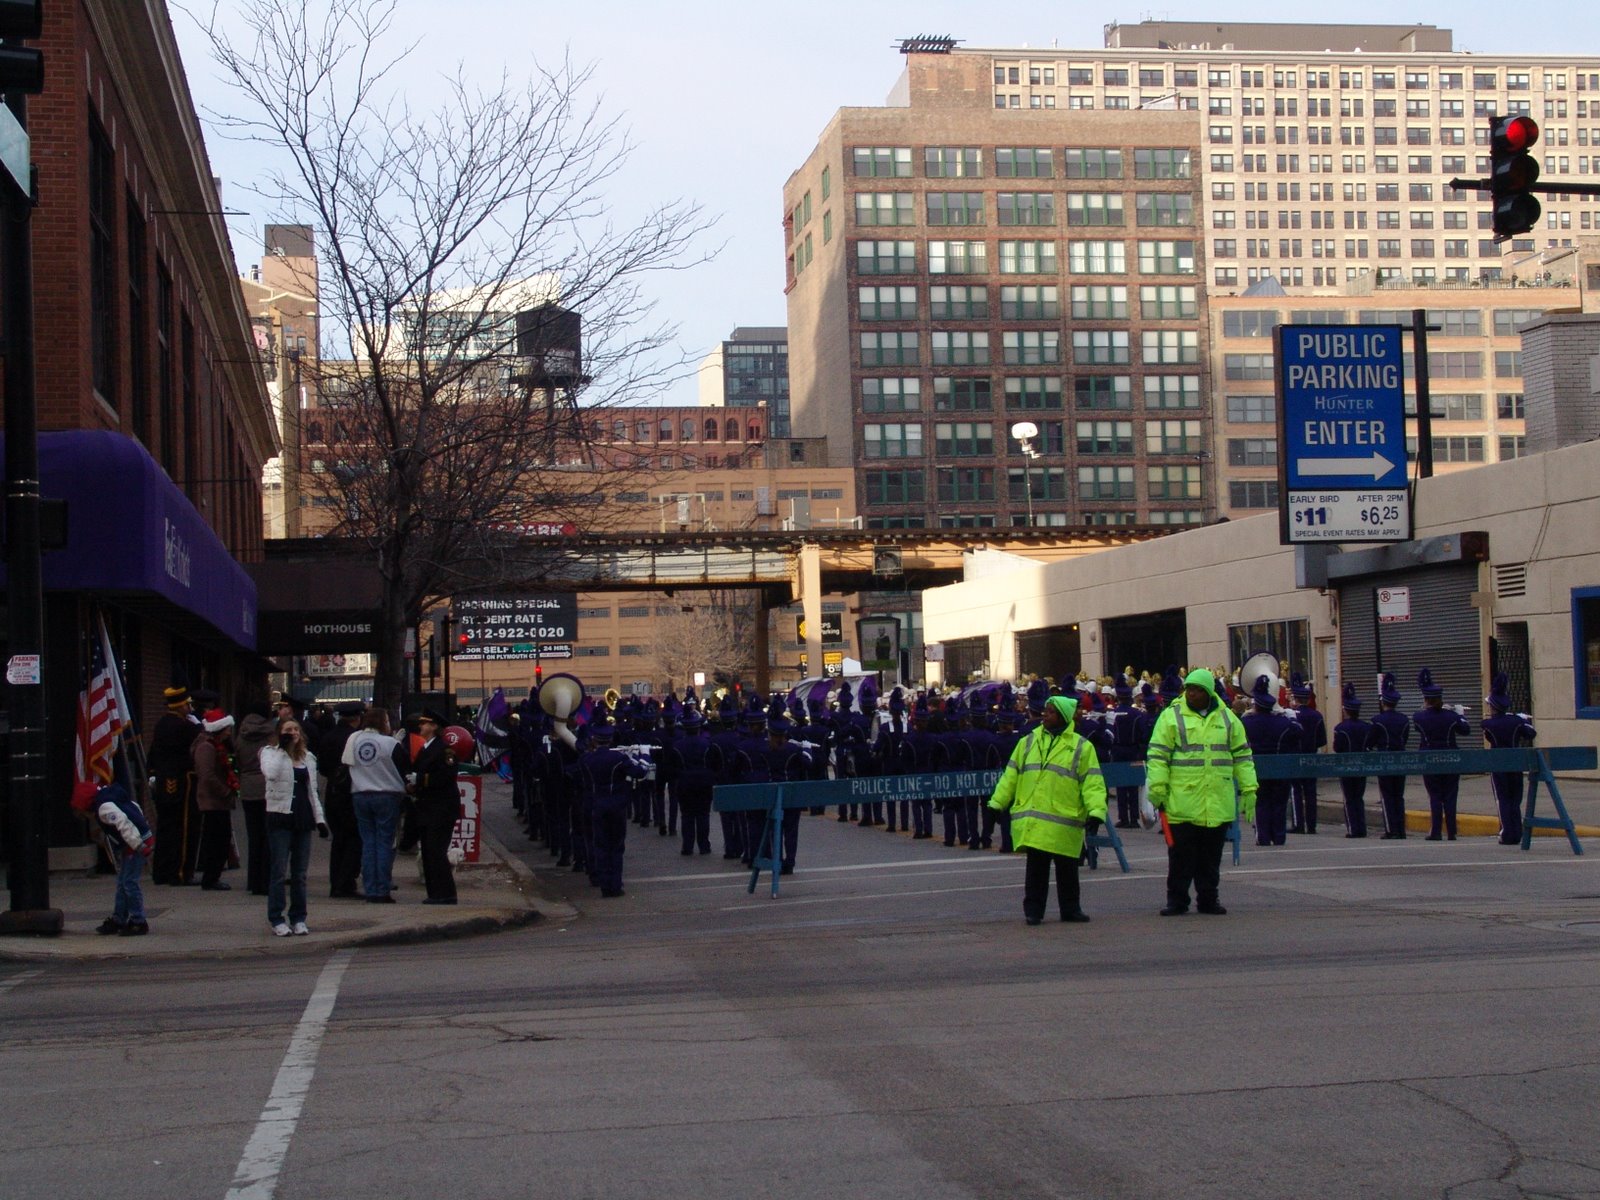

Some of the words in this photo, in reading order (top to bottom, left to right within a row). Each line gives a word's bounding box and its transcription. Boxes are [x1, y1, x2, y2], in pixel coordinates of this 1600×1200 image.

[1299, 334, 1386, 358] PUBLIC
[1289, 365, 1398, 389] PARKING
[1305, 421, 1386, 445] ENTER
[1319, 495, 1340, 503] BIRD
[1295, 507, 1326, 526] $11
[1361, 506, 1399, 525] $6.25
[516, 600, 561, 609] SPECIAL
[304, 624, 371, 634] HOTHOUSE
[462, 615, 513, 625] STDENT
[515, 614, 543, 624] RATE
[467, 627, 565, 639] 312-922-0020
[852, 778, 892, 796] POLICE
[898, 776, 922, 793] LINE
[934, 775, 950, 790] DO
[956, 773, 977, 789] NOT
[983, 771, 1005, 788] CR
[882, 792, 925, 801] CHICAGO
[930, 790, 963, 799] POLICE
[452, 818, 476, 839] ED
